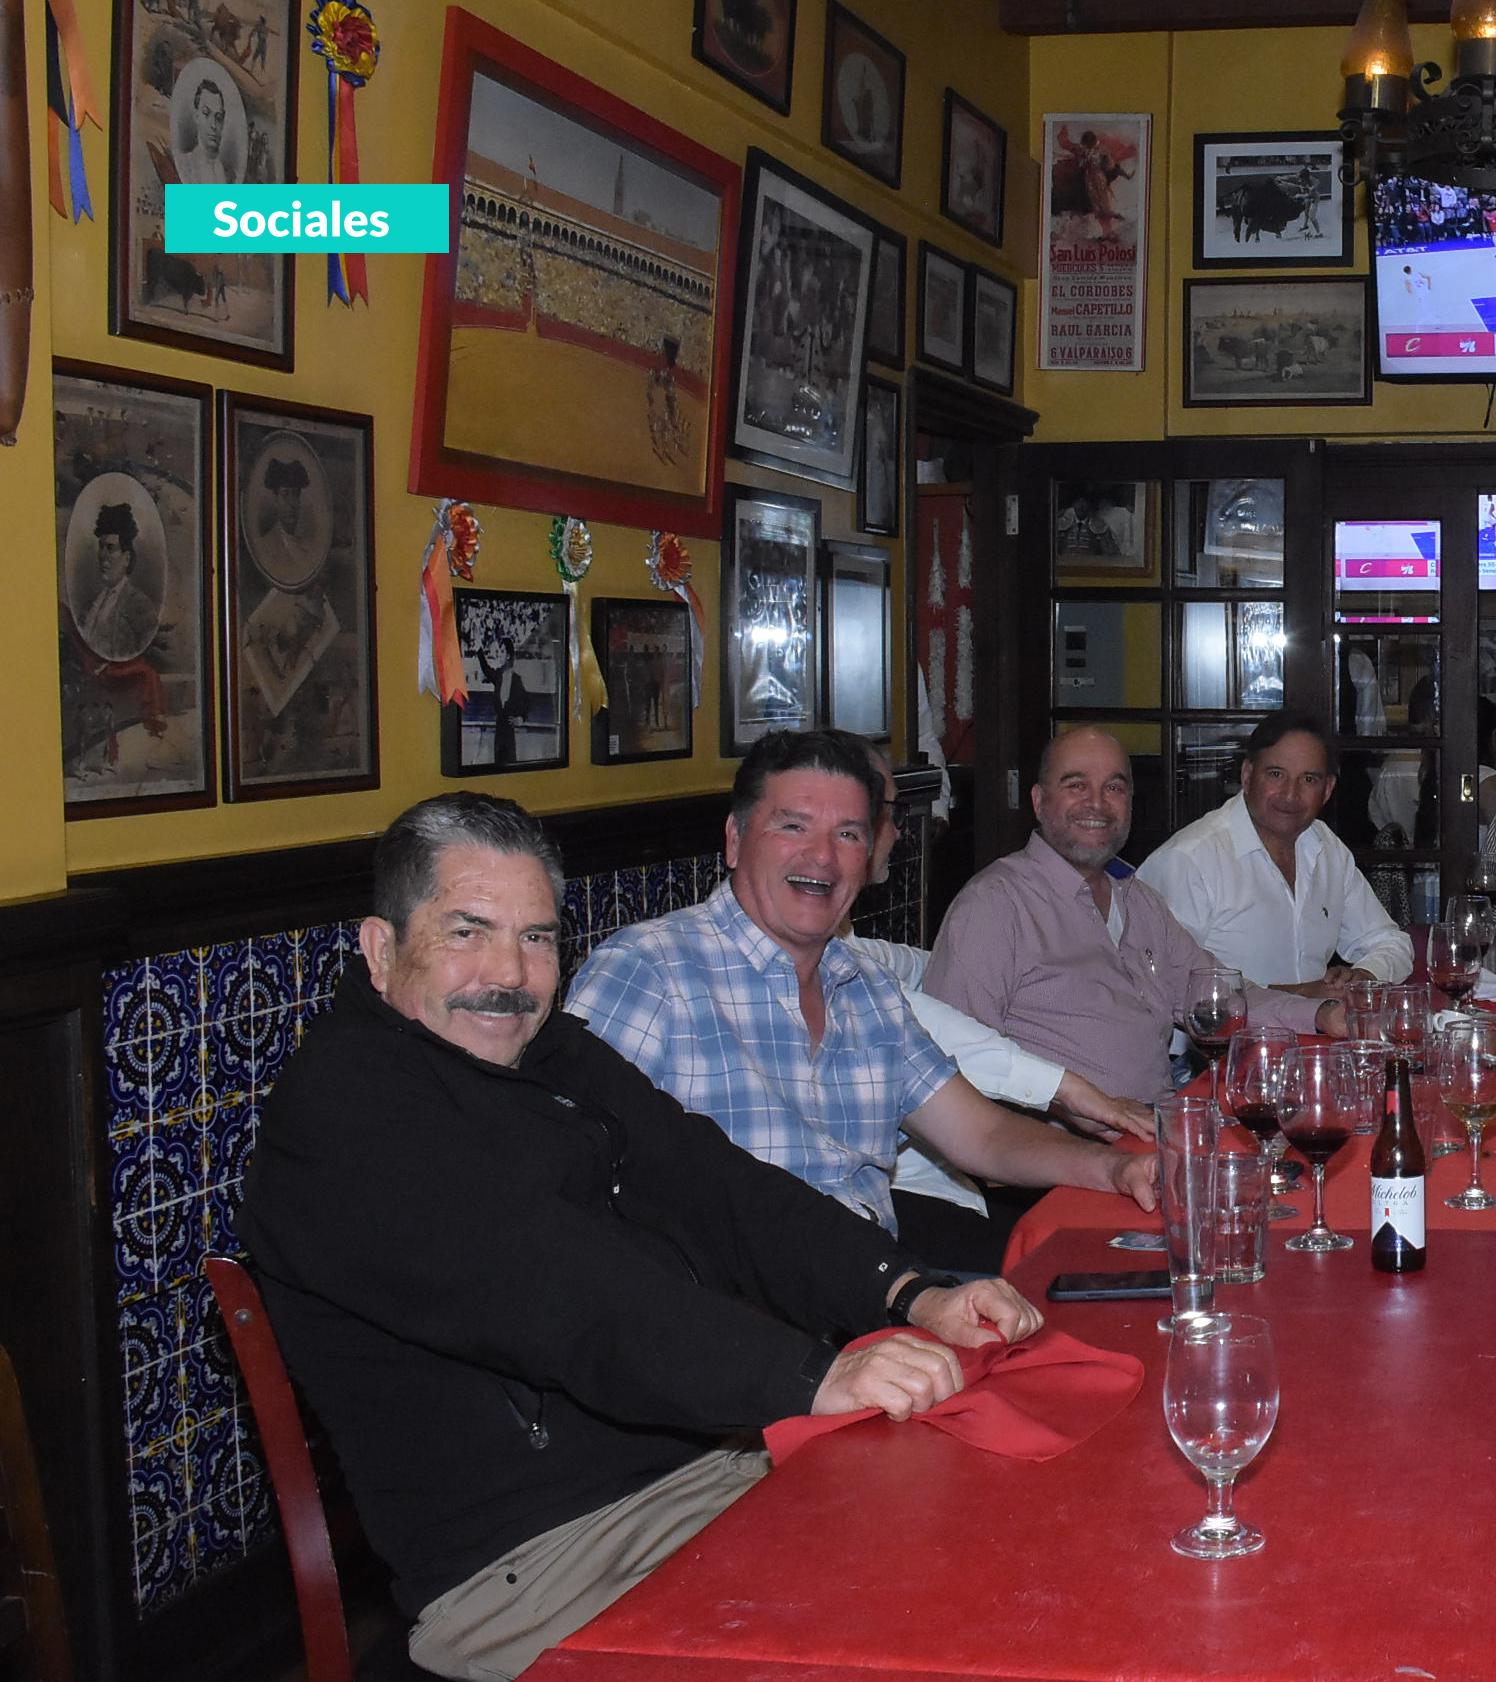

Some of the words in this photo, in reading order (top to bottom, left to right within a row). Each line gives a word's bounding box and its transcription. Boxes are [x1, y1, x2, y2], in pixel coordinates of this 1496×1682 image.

[1050, 244, 1072, 261] San
[1073, 244, 1097, 261] Luis
[1384, 246, 1428, 255] AT&T
[1052, 285, 1066, 298] EL
[1070, 285, 1133, 298] CORDOBES
[1075, 303, 1133, 316] CAPETILLO
[1051, 324, 1082, 337] RAUL
[1086, 324, 1132, 337] GARCIA
[1371, 1183, 1417, 1200] Michelob
